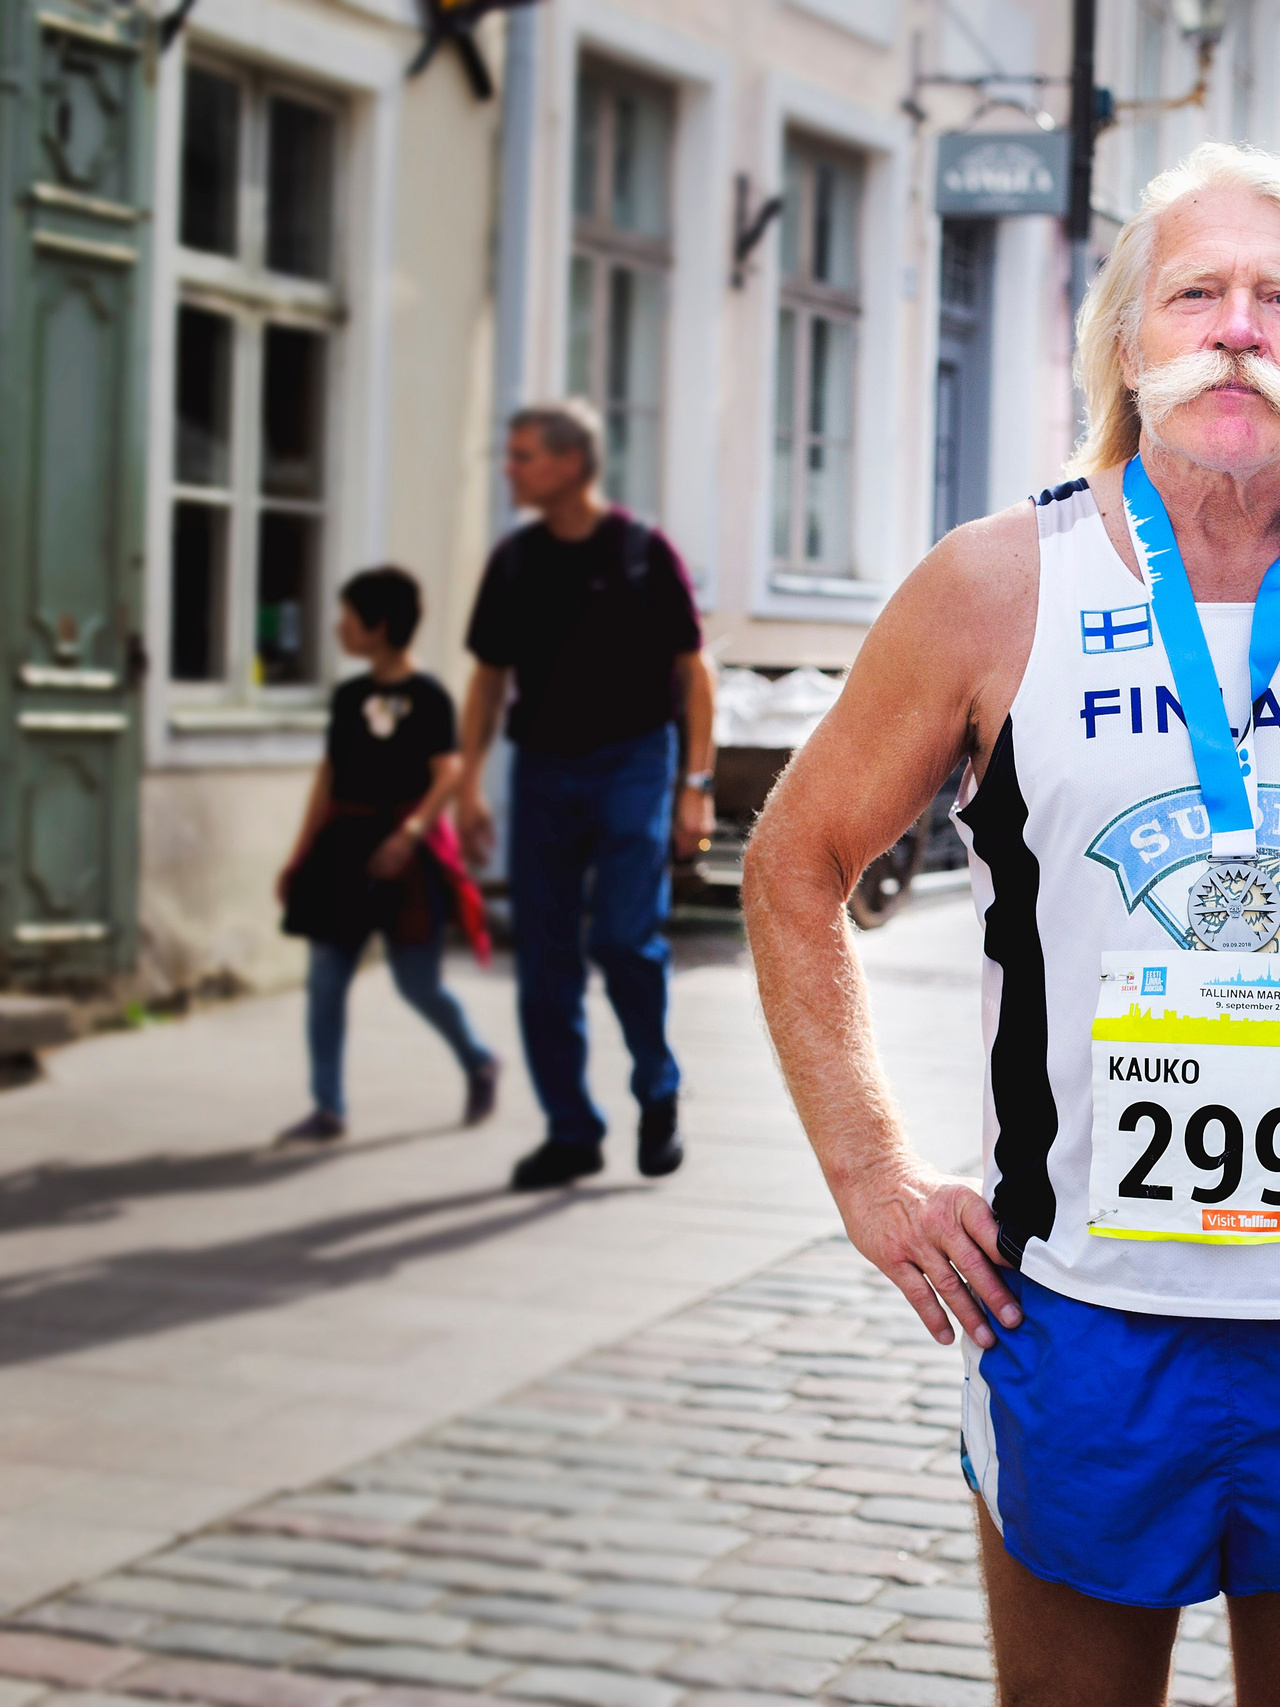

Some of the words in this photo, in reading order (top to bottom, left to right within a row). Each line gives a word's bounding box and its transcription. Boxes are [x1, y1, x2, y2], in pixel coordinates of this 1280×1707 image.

[1146, 970, 1162, 978] EESTI
[1200, 988, 1254, 999] TALLINNA
[1215, 1001, 1224, 1009] 9.
[1225, 1001, 1273, 1011] september
[1109, 1056, 1200, 1085] KAUKO
[1207, 1213, 1237, 1227] Visit
[1237, 1214, 1278, 1228] Tallinn
